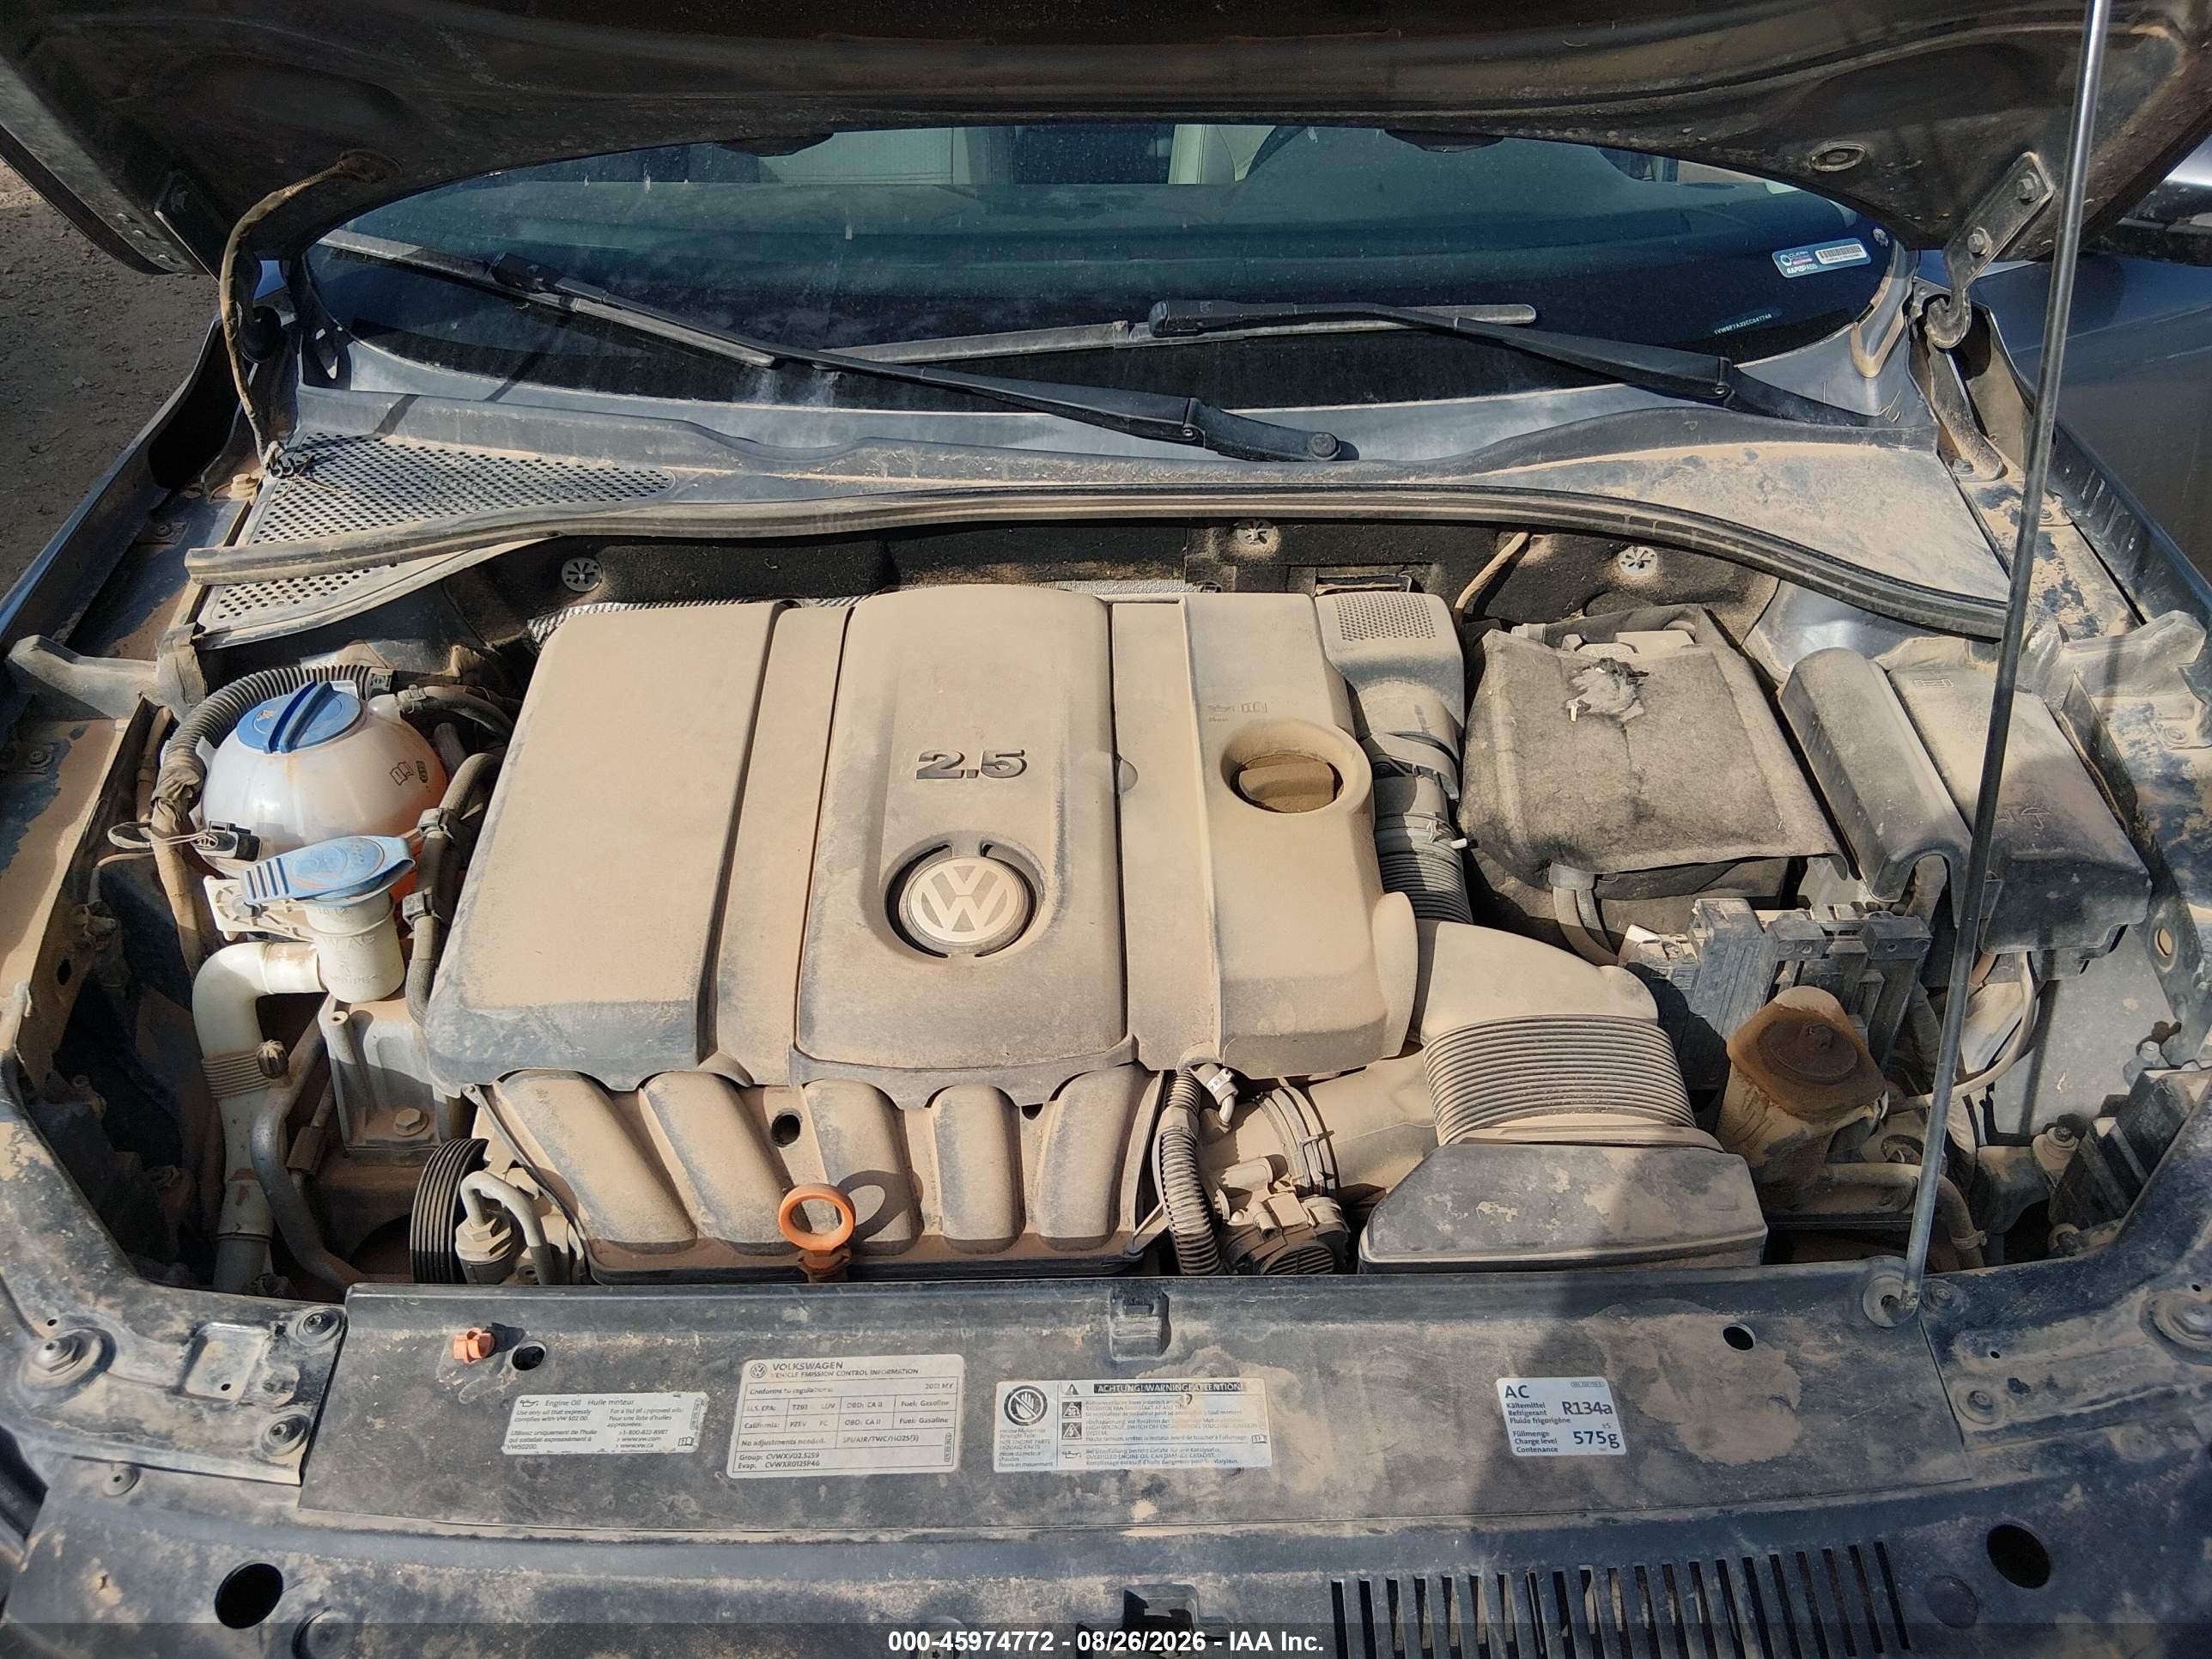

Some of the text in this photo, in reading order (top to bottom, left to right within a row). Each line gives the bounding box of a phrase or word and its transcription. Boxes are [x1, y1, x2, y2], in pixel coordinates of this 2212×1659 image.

[915, 749, 1028, 780] 2.5
[773, 1361, 843, 1370] VOLKSWAGEN
[1097, 1383, 1143, 1393] ACHTUNG!
[1505, 1384, 1530, 1399] AC
[545, 1400, 569, 1408] Engine
[1561, 1401, 1613, 1415] R134a
[1533, 1416, 1571, 1425] frigorigène
[1513, 1429, 1550, 1437] Füllmenge
[753, 1438, 796, 1448] adjustments
[1515, 1437, 1540, 1446] Charge
[1573, 1431, 1620, 1449] 575g
